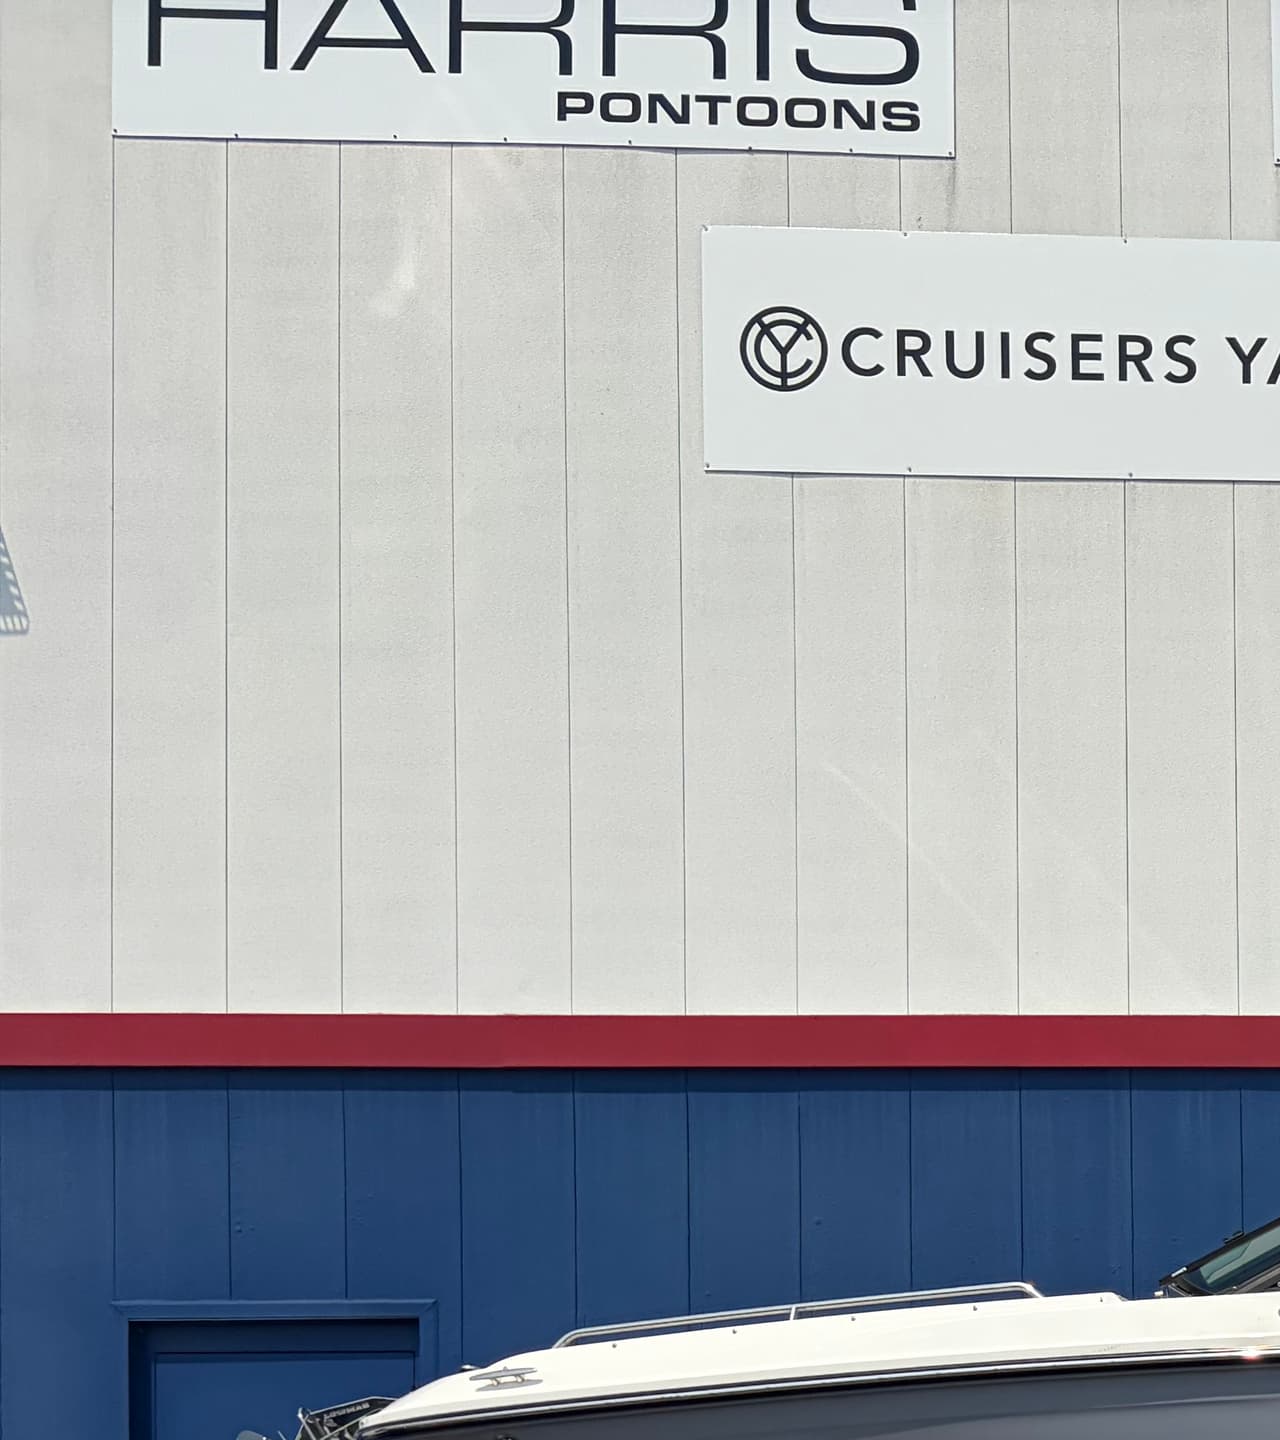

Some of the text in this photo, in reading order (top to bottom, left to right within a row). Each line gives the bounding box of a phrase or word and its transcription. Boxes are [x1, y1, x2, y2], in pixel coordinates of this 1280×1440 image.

[147, 0, 921, 86] HARRIS
[557, 91, 922, 132] PONTOONS
[841, 327, 1197, 384] CRUISERS
